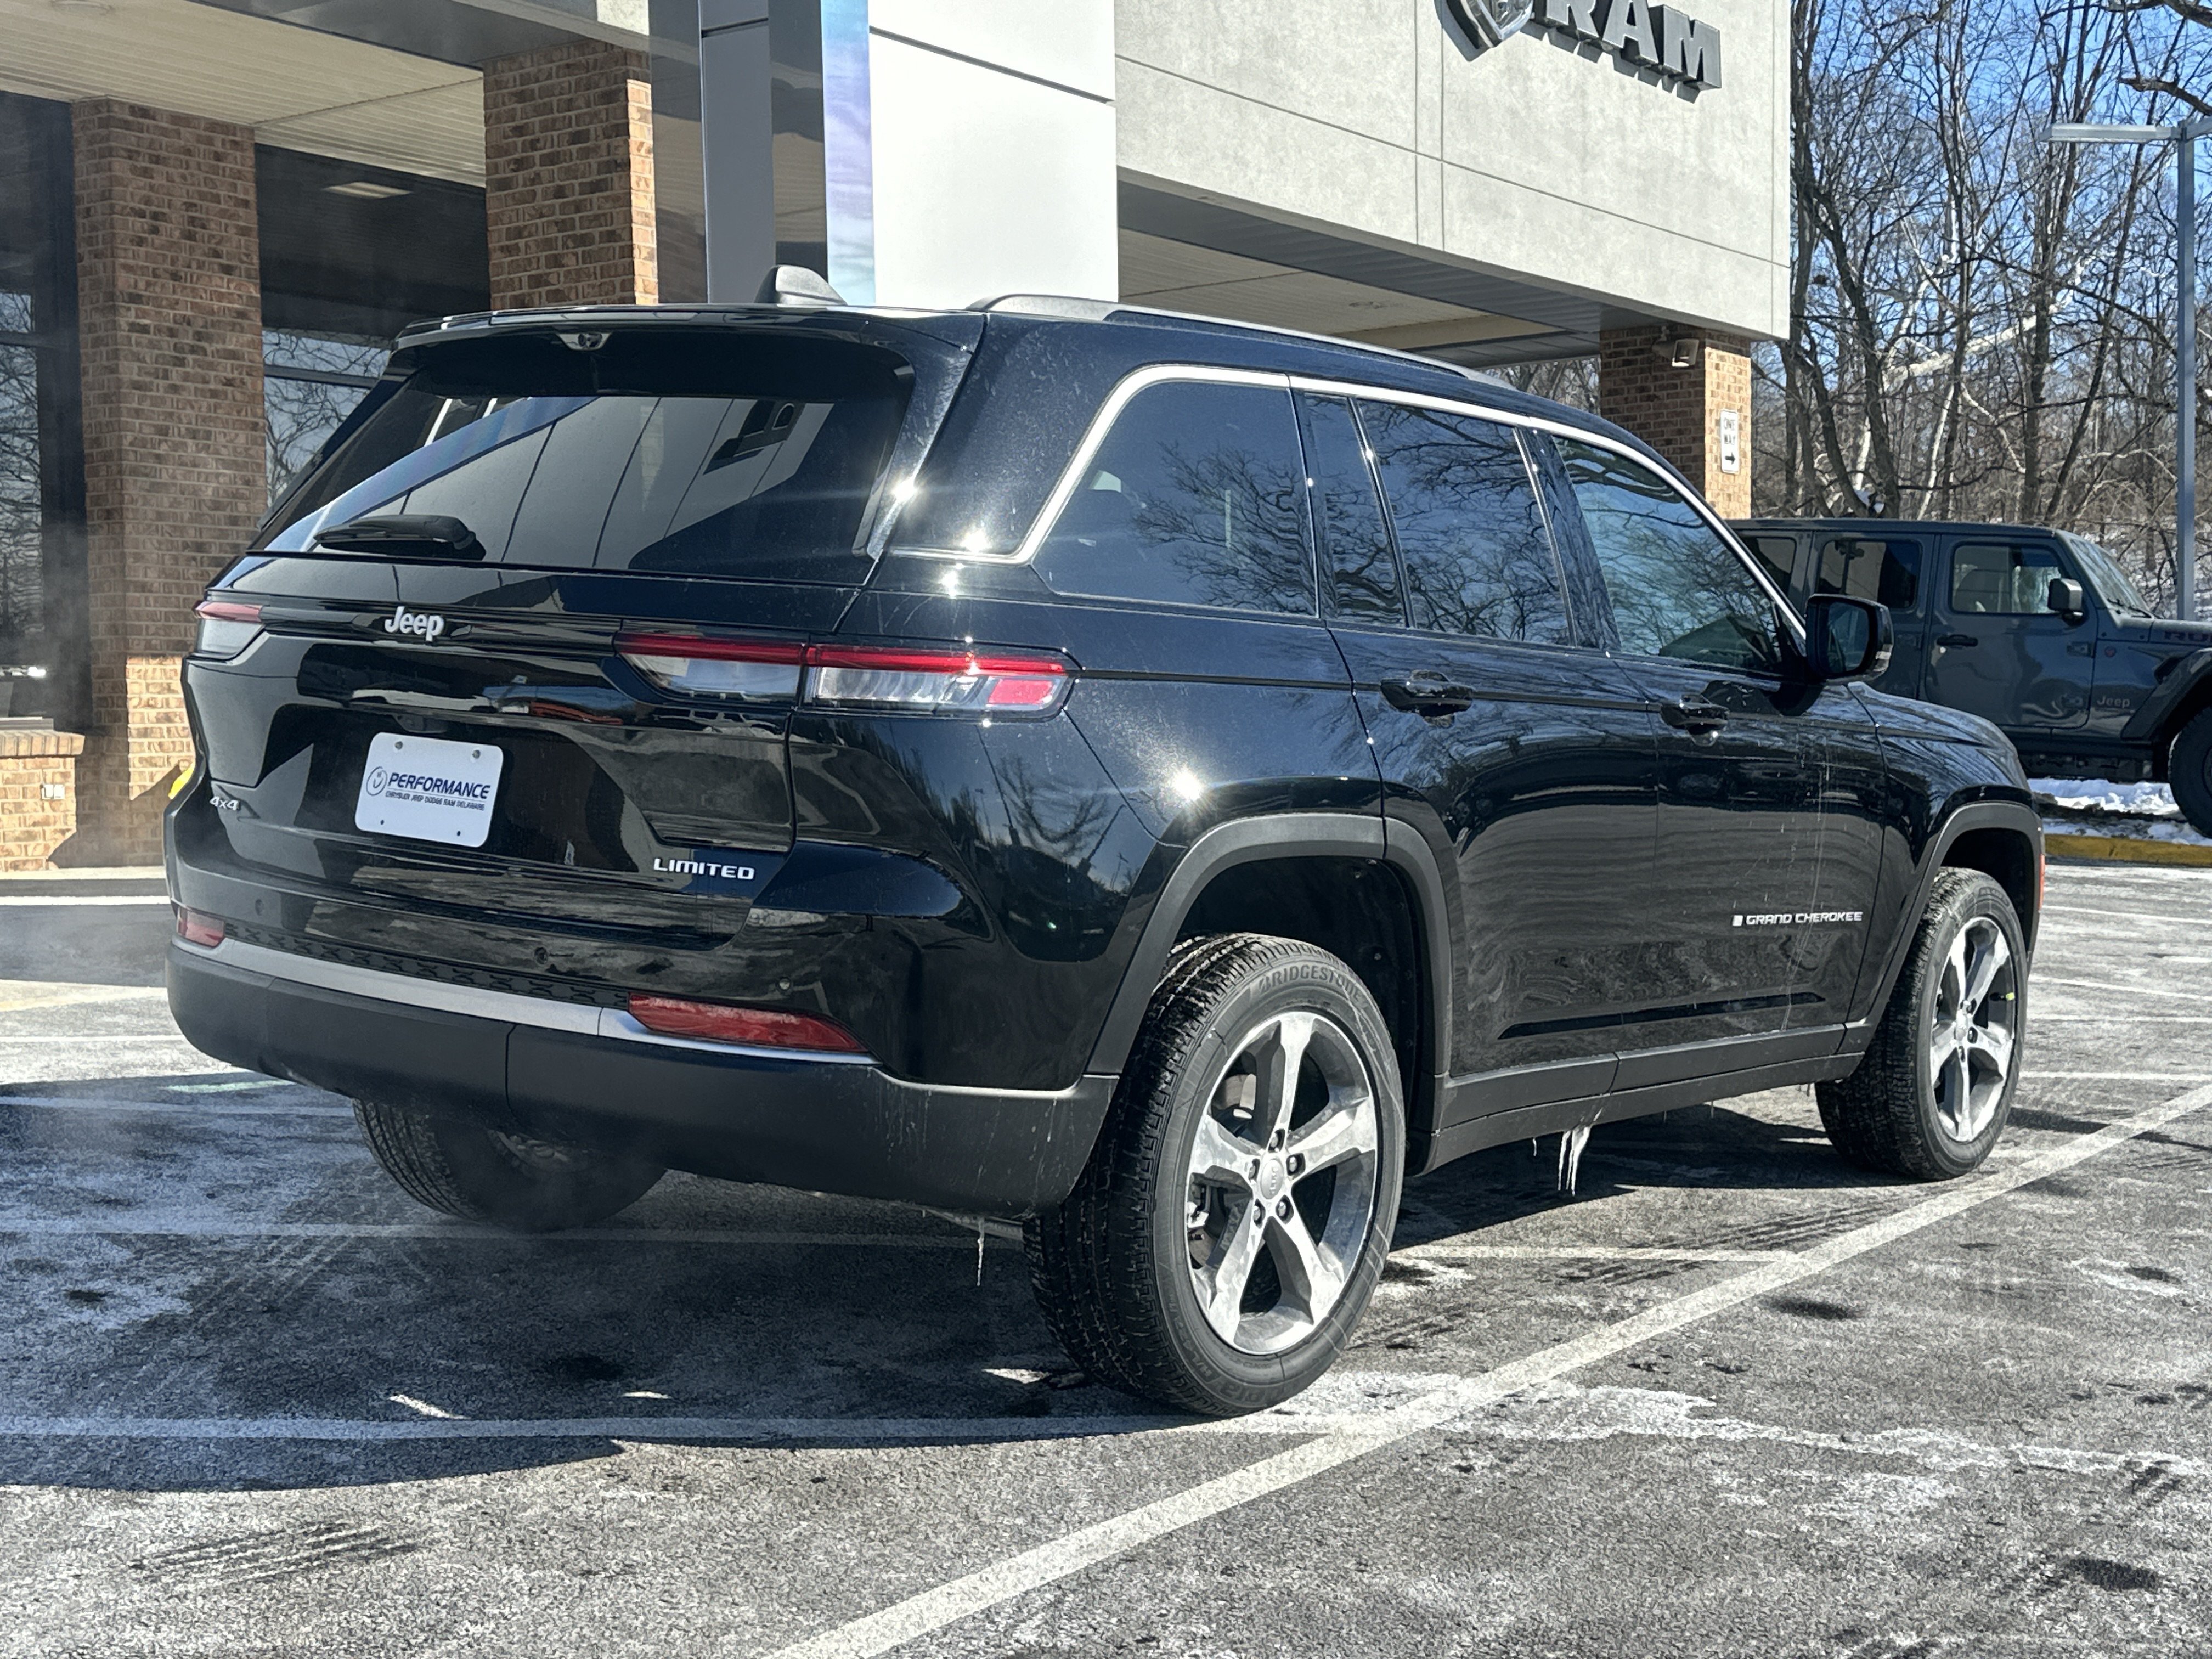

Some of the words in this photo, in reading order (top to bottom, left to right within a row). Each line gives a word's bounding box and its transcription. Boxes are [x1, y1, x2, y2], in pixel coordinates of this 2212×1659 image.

[1723, 417, 1735, 431] ONE
[1723, 435, 1736, 445] WAY
[385, 606, 444, 641] Jeep
[2164, 631, 2212, 642] RU
[2097, 696, 2130, 709] Jeep
[387, 772, 491, 799] PERFORMANCE
[653, 858, 755, 880] LIMITED
[1746, 913, 1792, 926] GRAND
[1795, 911, 1863, 923] CHEROKEE
[1259, 964, 1362, 1001] BRIDGESTONE
